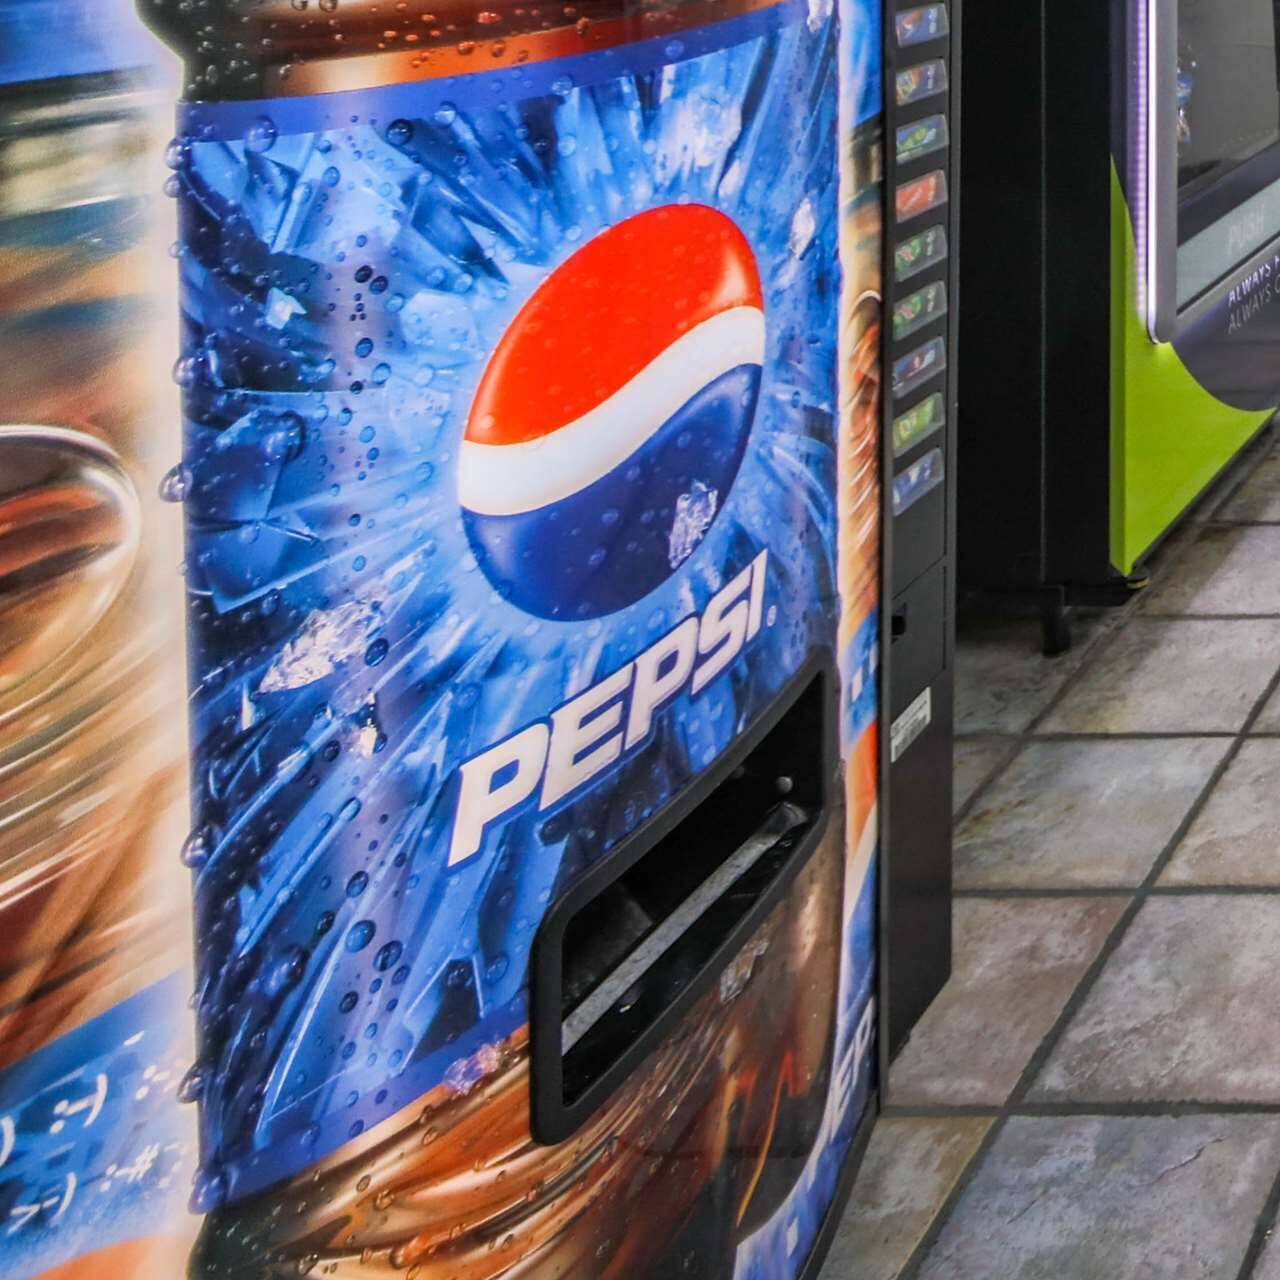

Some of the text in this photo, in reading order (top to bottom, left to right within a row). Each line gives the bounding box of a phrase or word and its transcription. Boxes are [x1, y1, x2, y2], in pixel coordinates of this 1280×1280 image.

[1227, 283, 1272, 335] ALWAYS
[1228, 263, 1272, 308] ALWAYS
[447, 548, 769, 868] PEPSI
